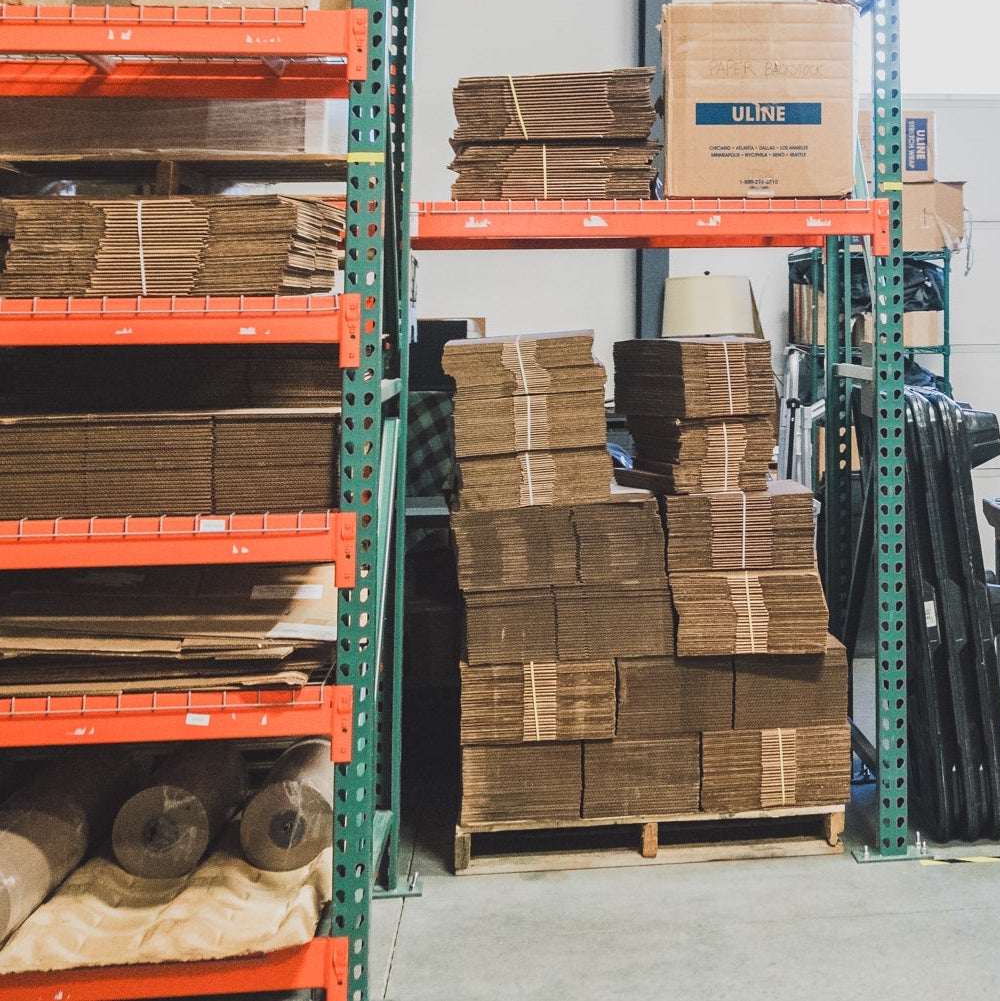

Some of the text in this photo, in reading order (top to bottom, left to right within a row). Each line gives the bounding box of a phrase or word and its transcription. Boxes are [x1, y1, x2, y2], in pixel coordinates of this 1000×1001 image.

[709, 60, 757, 78] PAPER
[731, 104, 786, 122] ULINE
[916, 129, 926, 160] ULINE
[908, 149, 916, 169] WRAP
